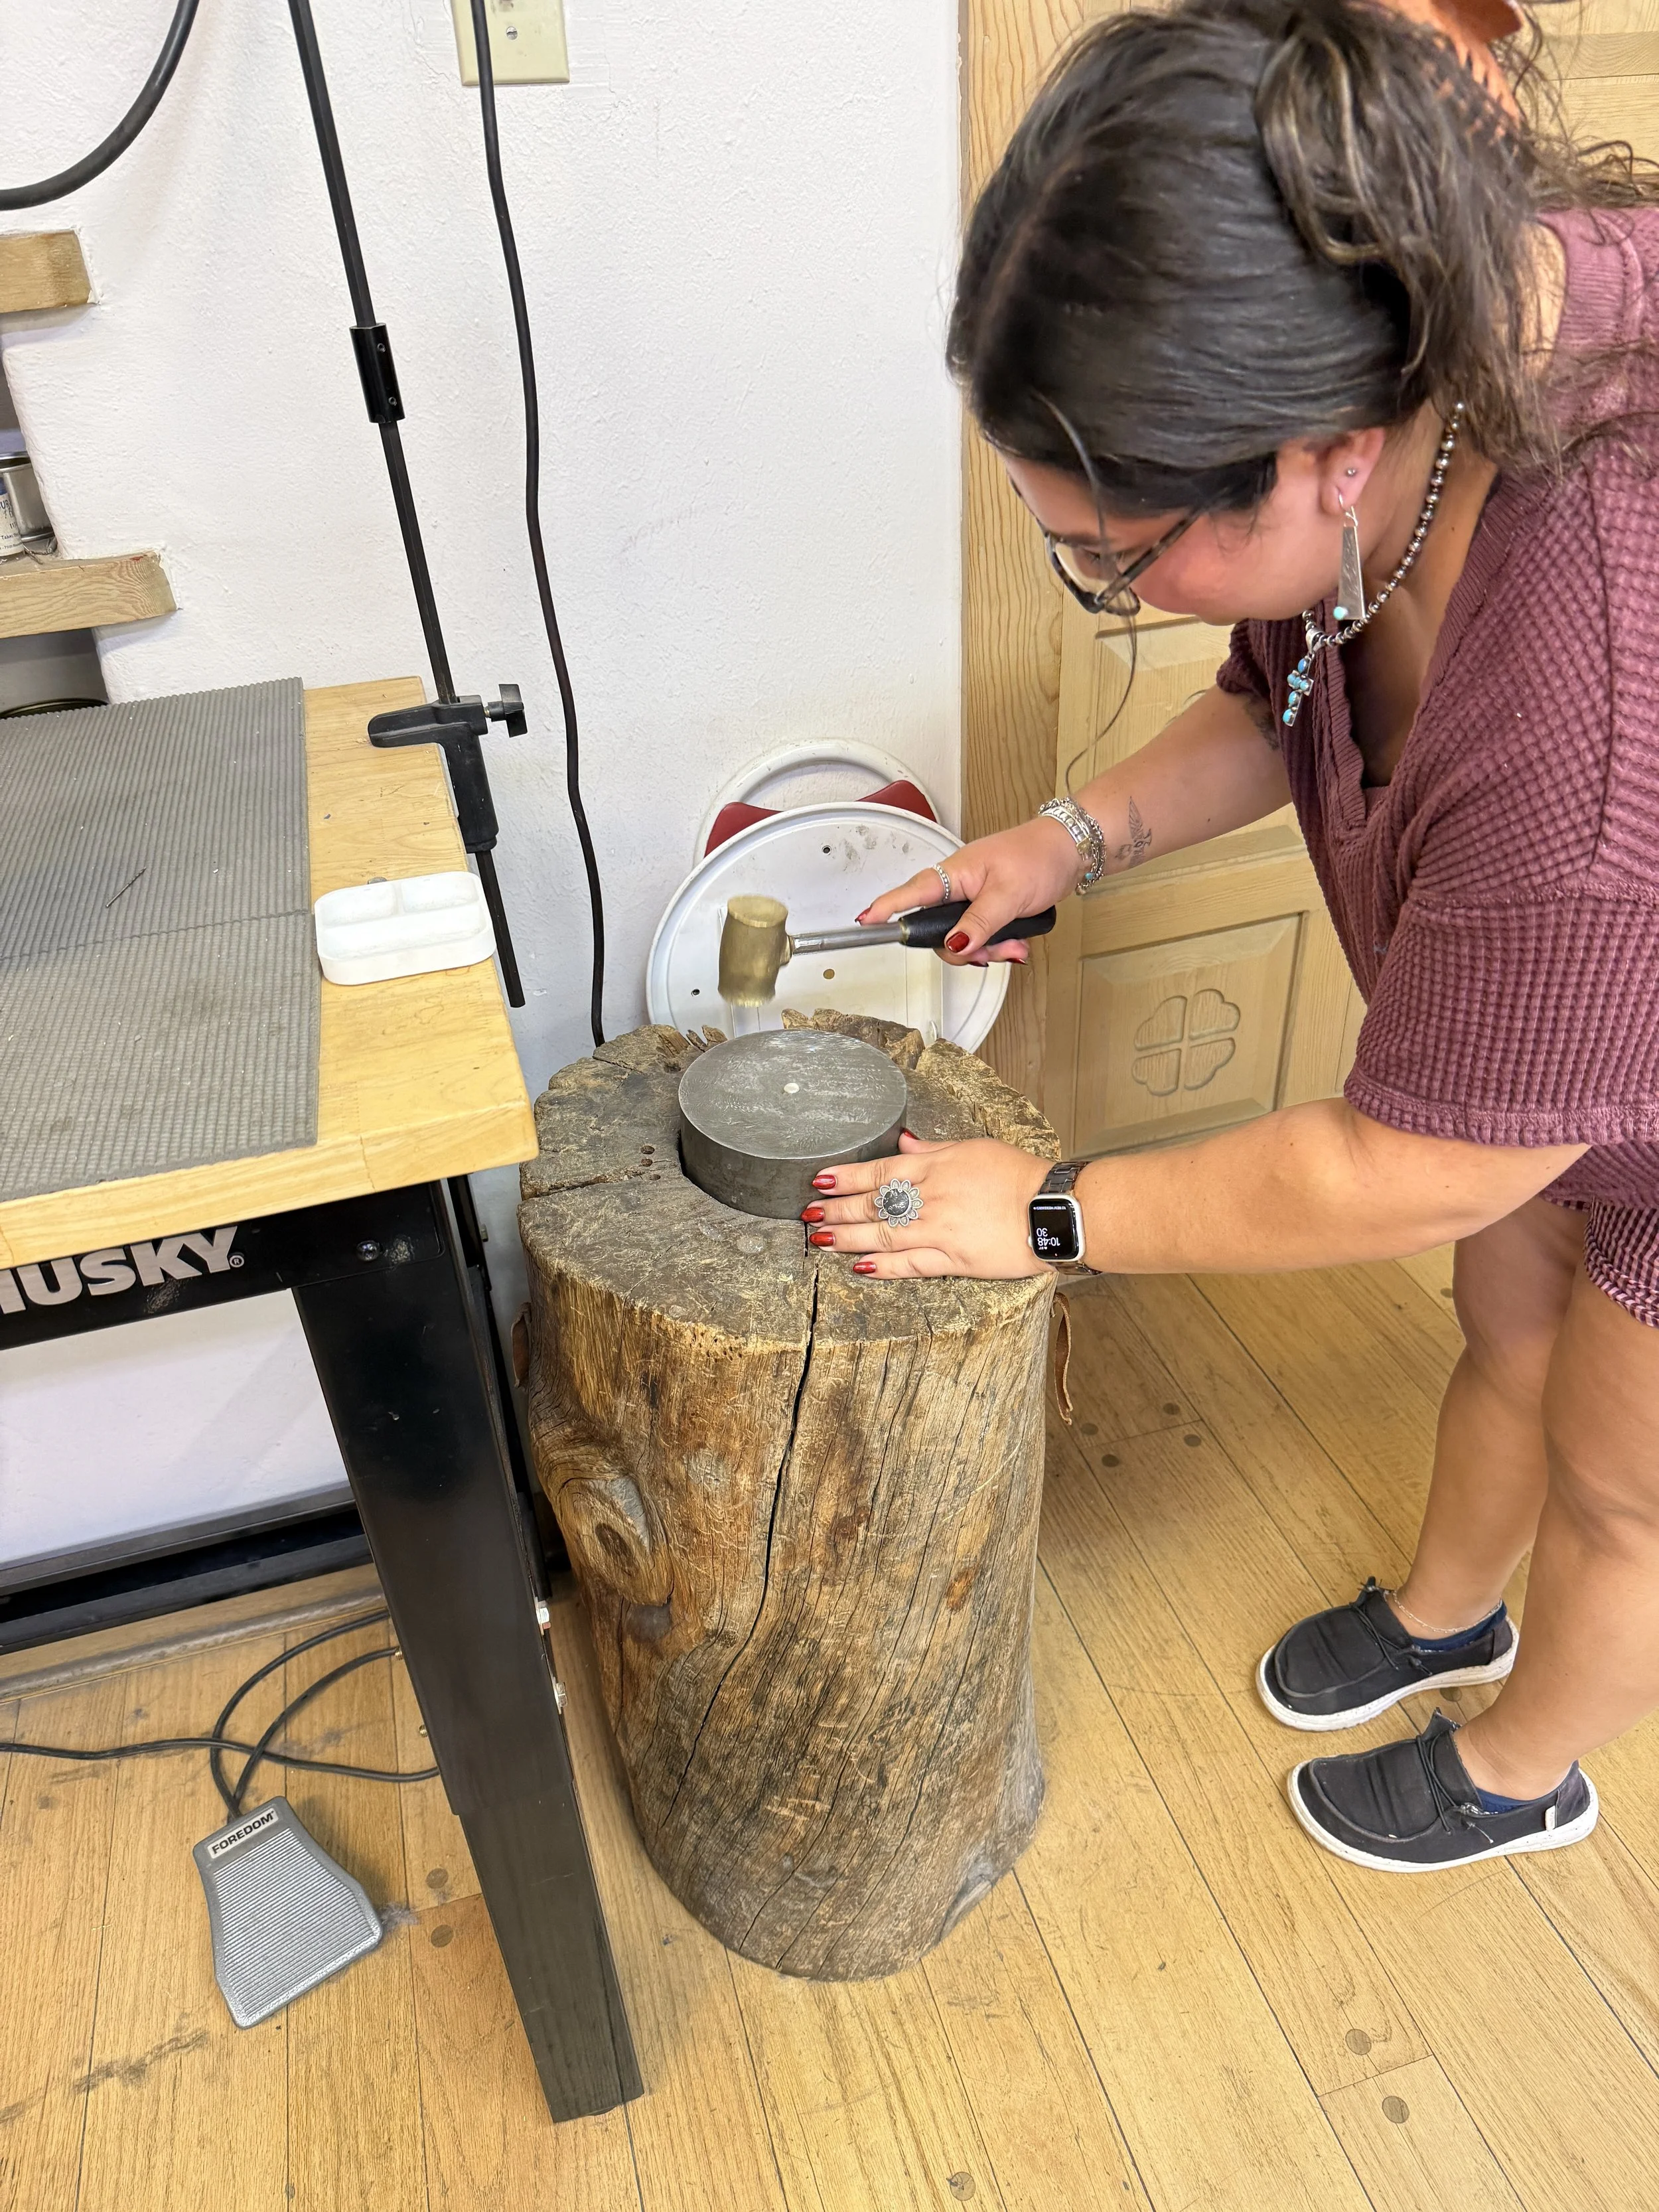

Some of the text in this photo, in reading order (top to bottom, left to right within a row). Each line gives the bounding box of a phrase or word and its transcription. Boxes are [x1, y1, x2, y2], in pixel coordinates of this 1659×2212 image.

[1037, 1228, 1048, 1236] 30
[1037, 1237, 1060, 1246] 10:48
[212, 1812, 273, 1854] FOREDOM
